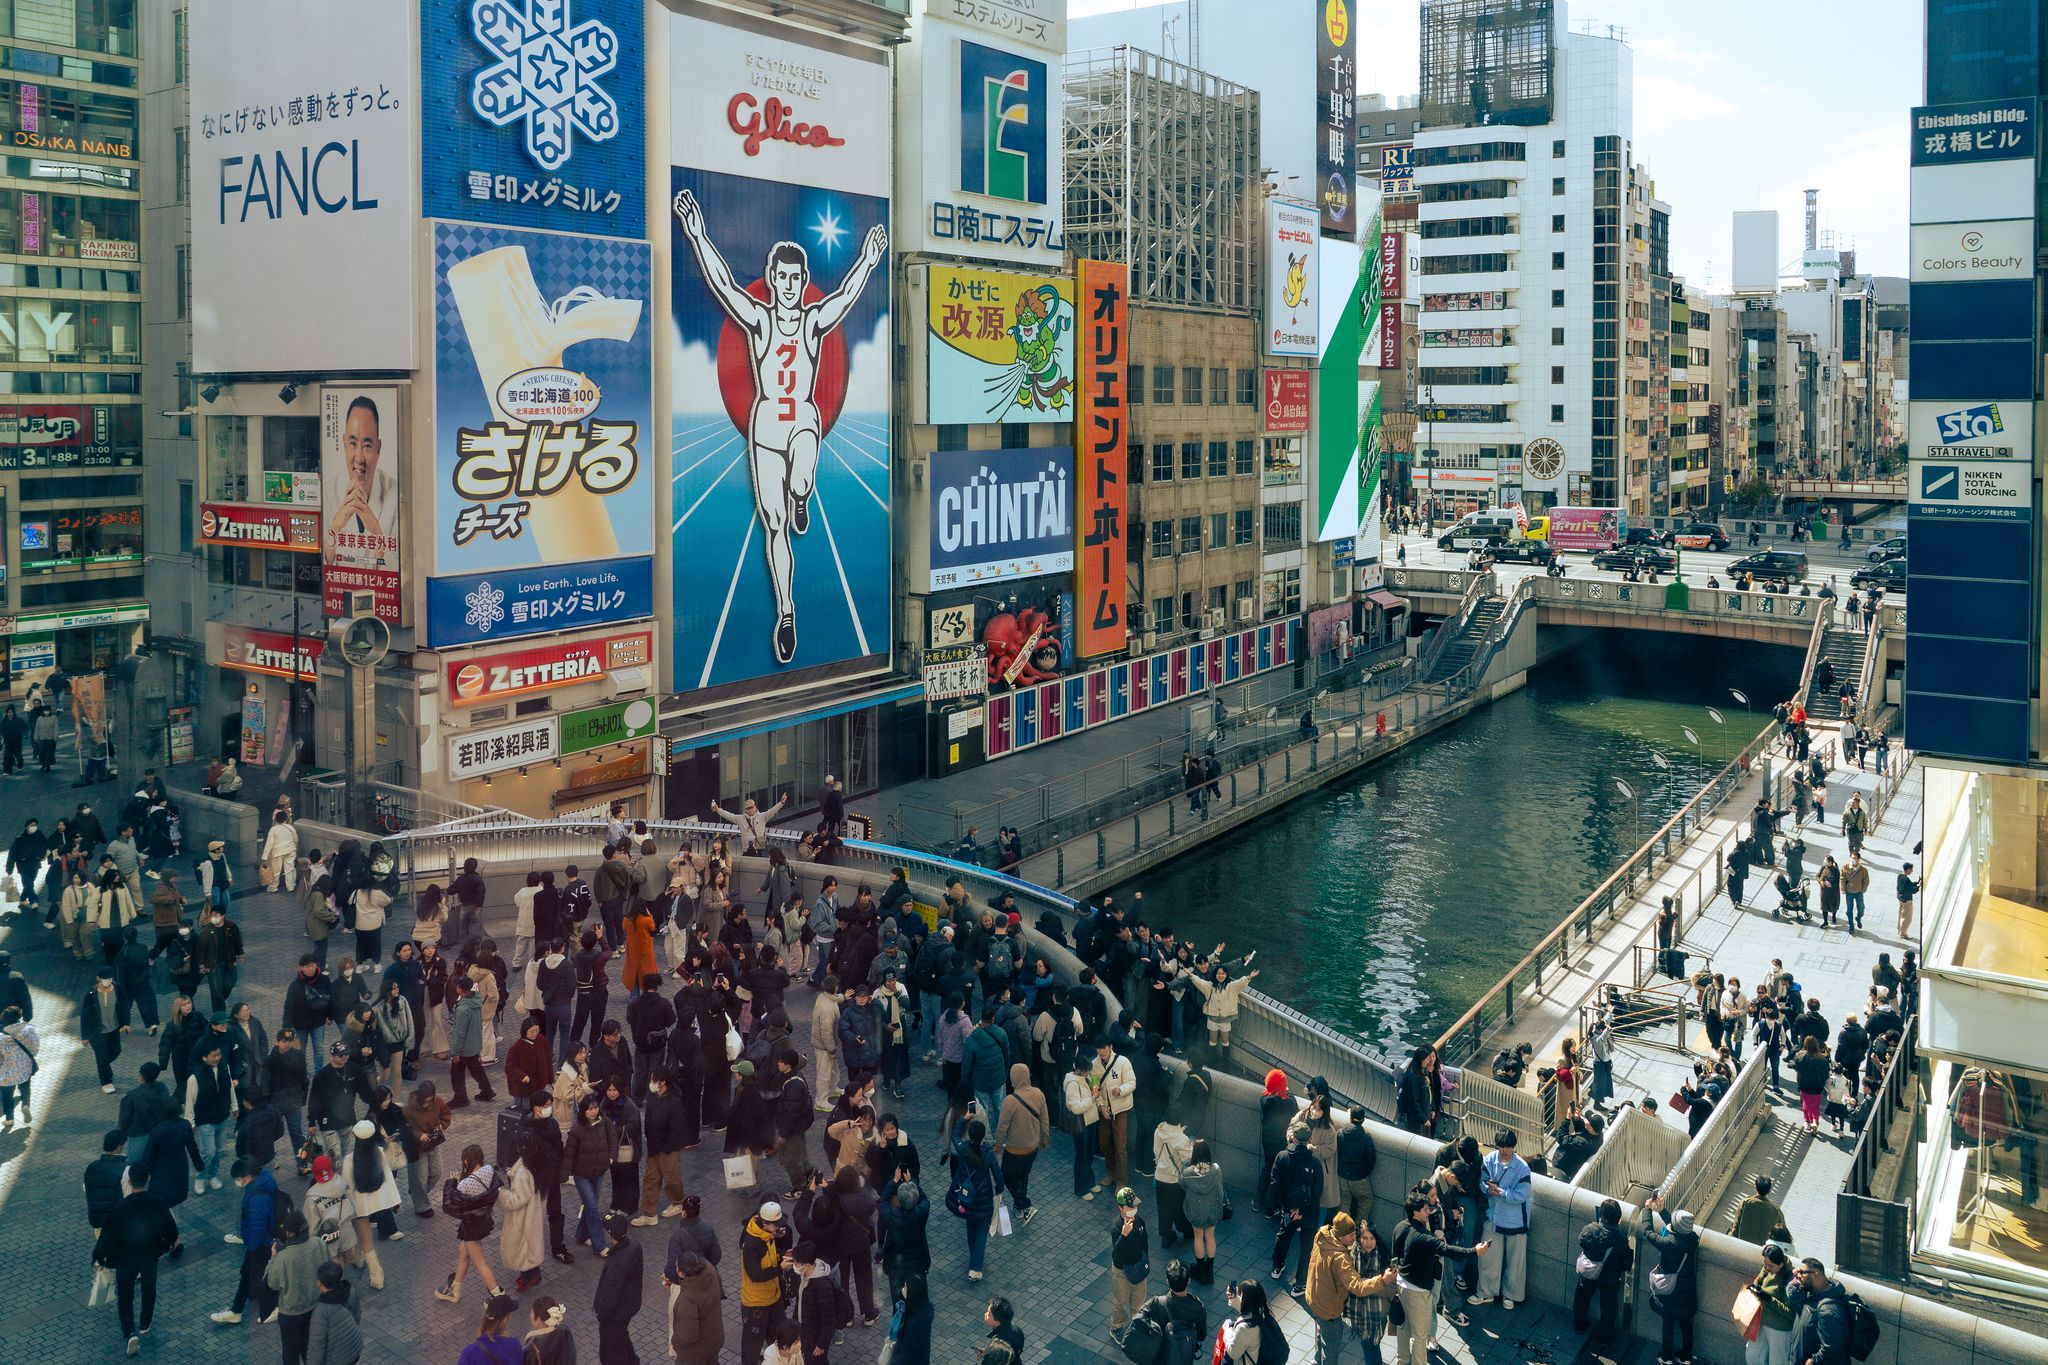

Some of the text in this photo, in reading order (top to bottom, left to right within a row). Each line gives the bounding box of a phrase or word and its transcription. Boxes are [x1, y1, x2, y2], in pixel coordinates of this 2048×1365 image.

[953, 1, 1046, 41] エステムシリーズ
[752, 72, 822, 100] ゆたかな人生
[201, 84, 401, 138] なにげない感動をずっと。
[1329, 54, 1345, 167] 千里眼
[1918, 109, 2028, 129] Ebisubashi Bldg.
[728, 92, 845, 157] Glico
[16, 132, 76, 151] OSAKA
[1925, 129, 2021, 154] 戎橋ビル
[219, 139, 378, 225] FANCL
[468, 170, 622, 214] 雪印メグミルク
[933, 201, 1065, 251] 日商エステム
[1278, 228, 1313, 246] キュービクル
[82, 241, 136, 251] YAKINIKU
[82, 249, 136, 260] RIKIMARU
[1384, 235, 1396, 288] カラオケ
[1923, 255, 2023, 270] Colors Beauty
[948, 277, 1000, 302] かぜに
[942, 303, 1005, 341] 改源
[1282, 332, 1316, 346] 日本電機産業
[1384, 306, 1396, 367] ネットカフェ
[526, 374, 574, 387] STRING CHEESE
[776, 340, 798, 421] グリコ
[20, 414, 75, 440] 風月
[1943, 404, 2003, 437] sta TRAVEL
[85, 446, 110, 454] 11:00
[85, 457, 111, 465] 23:00
[453, 419, 639, 500] さける
[1092, 283, 1119, 630] オリエントホーム
[1931, 447, 1991, 457] STA TRAVEL
[1965, 472, 2002, 480] NIKKEN
[1965, 480, 1996, 488] TOTAL
[1965, 488, 2016, 497] SOURCING
[939, 461, 1066, 552] CHINTAI
[1922, 507, 2017, 517] 日研トータルソーシング株式会社
[219, 517, 285, 542] ZETTERIA
[454, 501, 529, 545] チーズ
[338, 534, 397, 551] 東京美容外科
[326, 571, 399, 588] 大阪駅前第1ビル 2F
[518, 573, 619, 594] Love Earth. Love Life.
[512, 589, 626, 624] 雪印メグミルク
[75, 614, 112, 625] FamilyMart
[13, 644, 52, 654] FamilyMart
[565, 650, 590, 659] ゼッテリア
[623, 656, 644, 664] コーヒー
[490, 656, 602, 691] ZETTERIA
[928, 666, 979, 694] 大阪に乾杯
[459, 728, 550, 768] 若耶溪紹興酒
